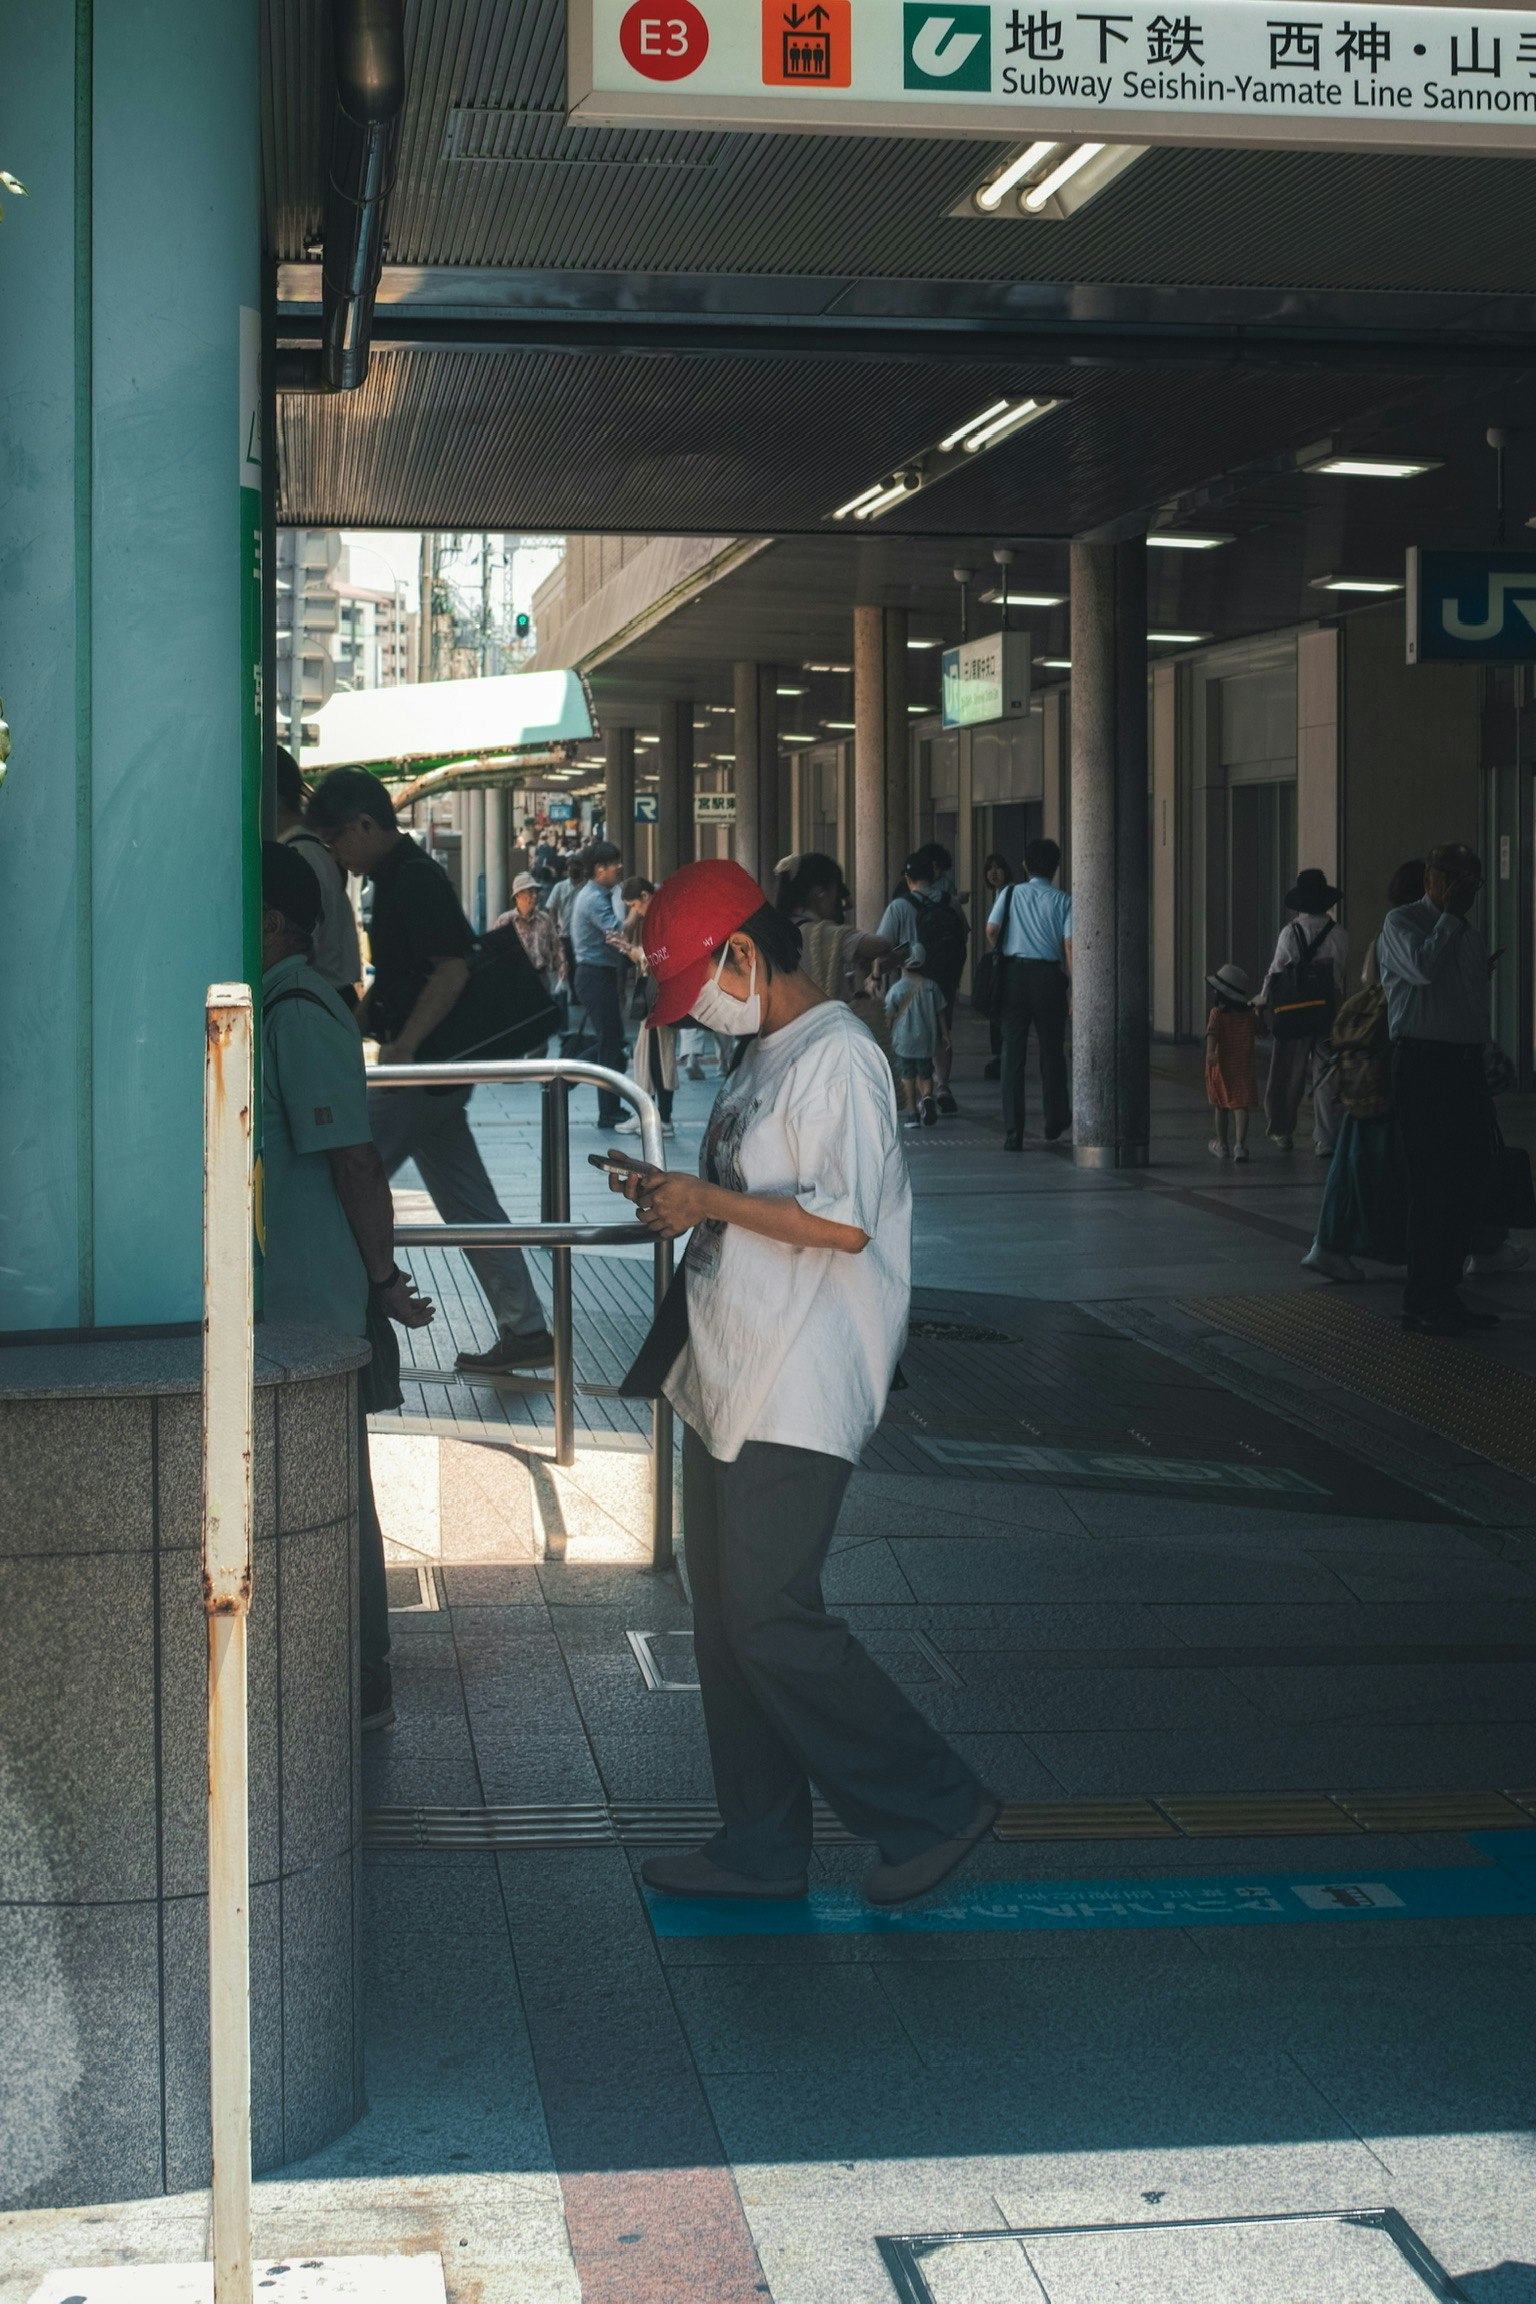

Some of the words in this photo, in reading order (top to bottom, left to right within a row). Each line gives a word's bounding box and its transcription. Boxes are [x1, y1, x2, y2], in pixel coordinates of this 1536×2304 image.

[640, 19, 688, 56] E3
[1004, 10, 1205, 68] 地下鉄
[1002, 67, 1113, 103] Subway
[1123, 71, 1342, 105] Seishin-Yamate
[1354, 79, 1413, 108] Line
